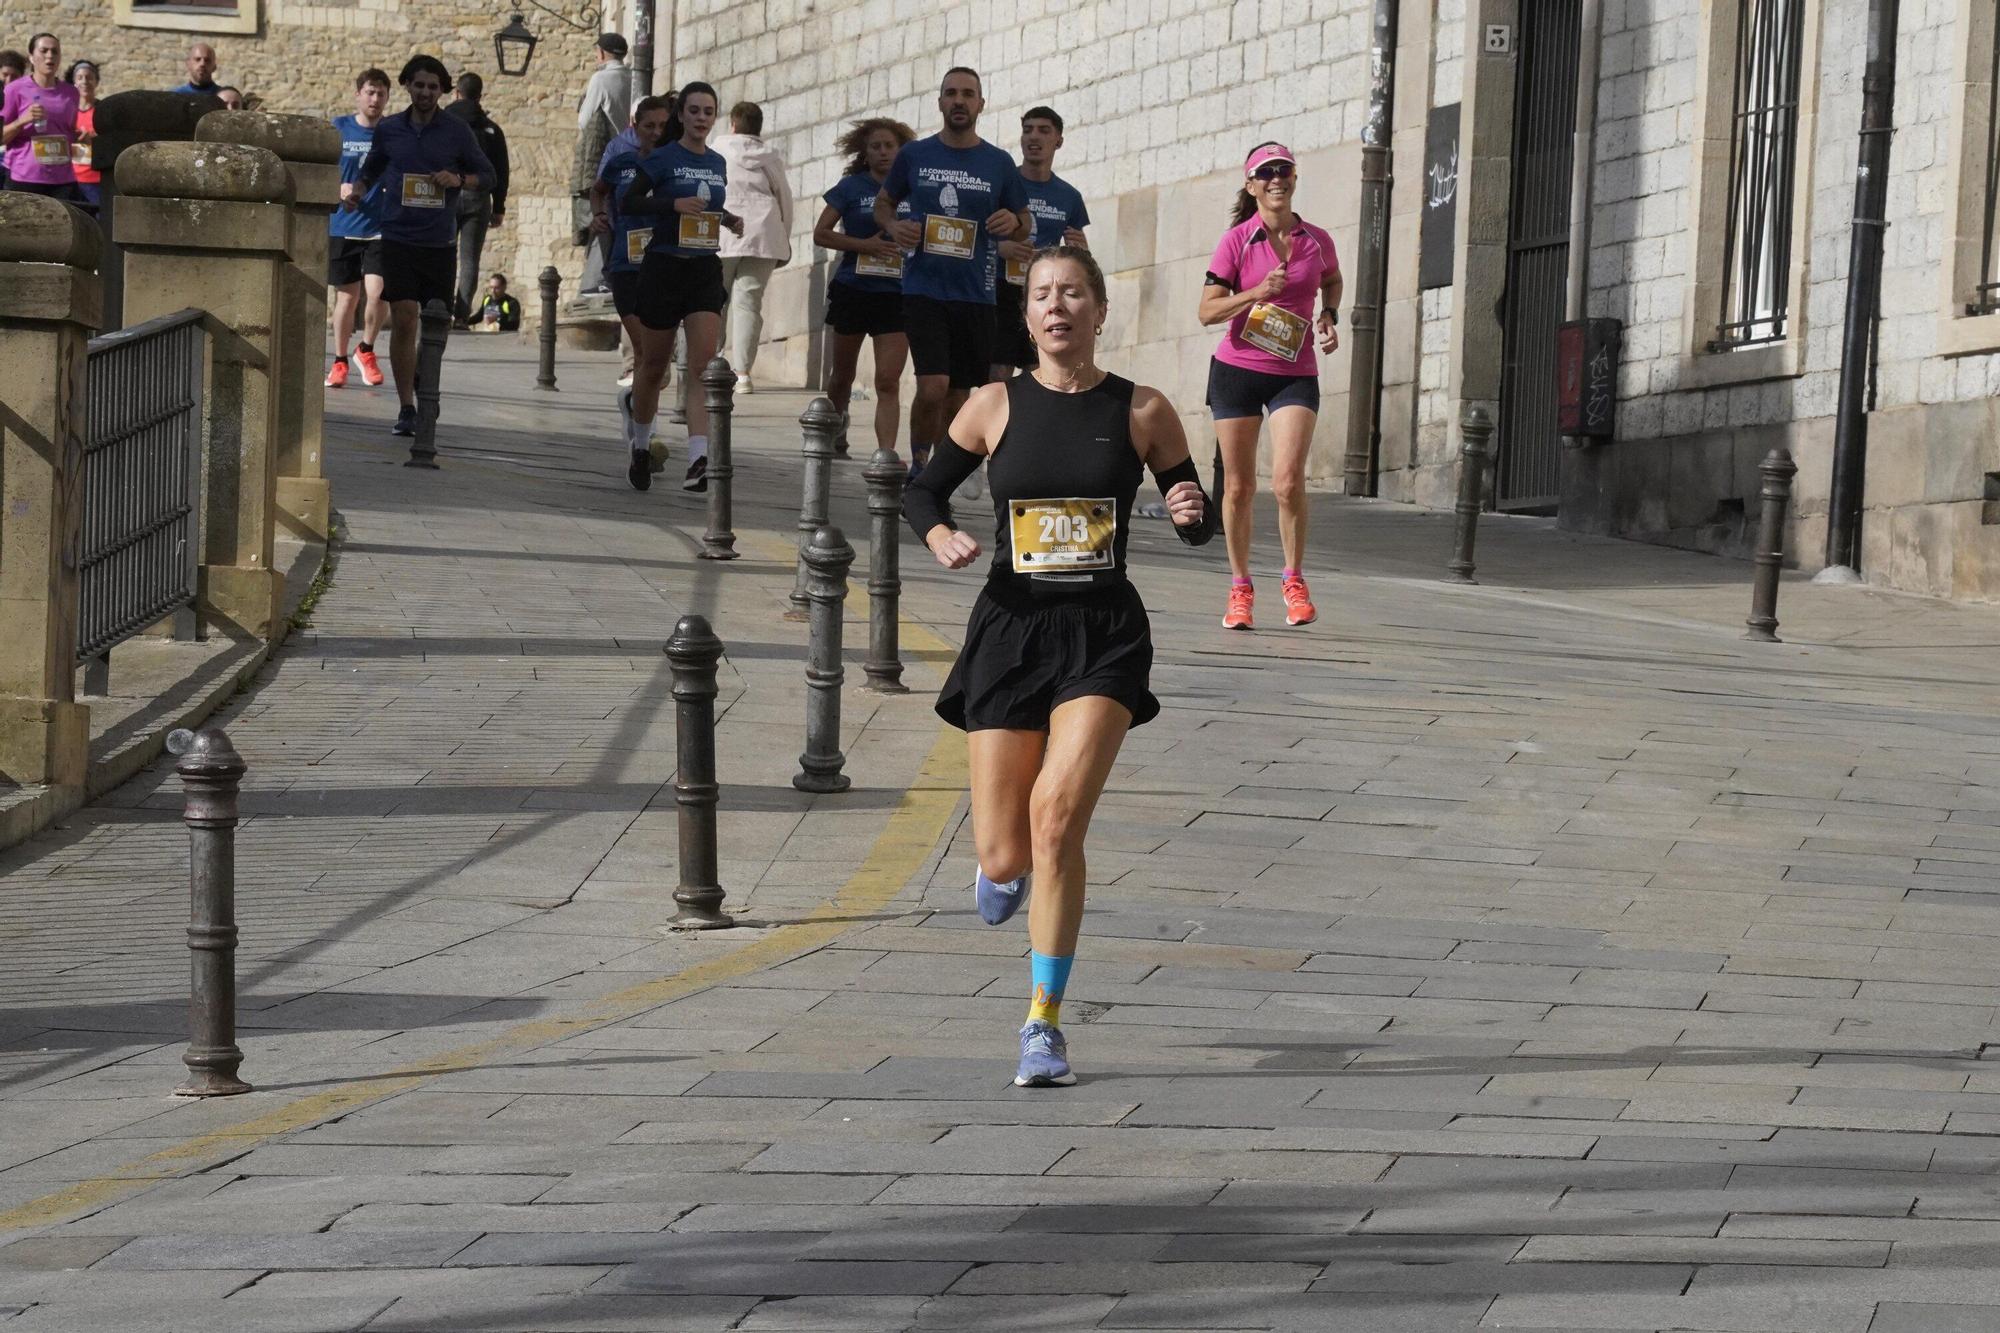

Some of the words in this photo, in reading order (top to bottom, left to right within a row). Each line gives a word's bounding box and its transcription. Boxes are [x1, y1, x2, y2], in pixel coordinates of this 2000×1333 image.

[928, 174, 982, 185] ALMENDRA
[696, 221, 709, 235] 16
[937, 225, 964, 242] 680
[1262, 314, 1293, 341] 595
[1039, 515, 1088, 543] 203
